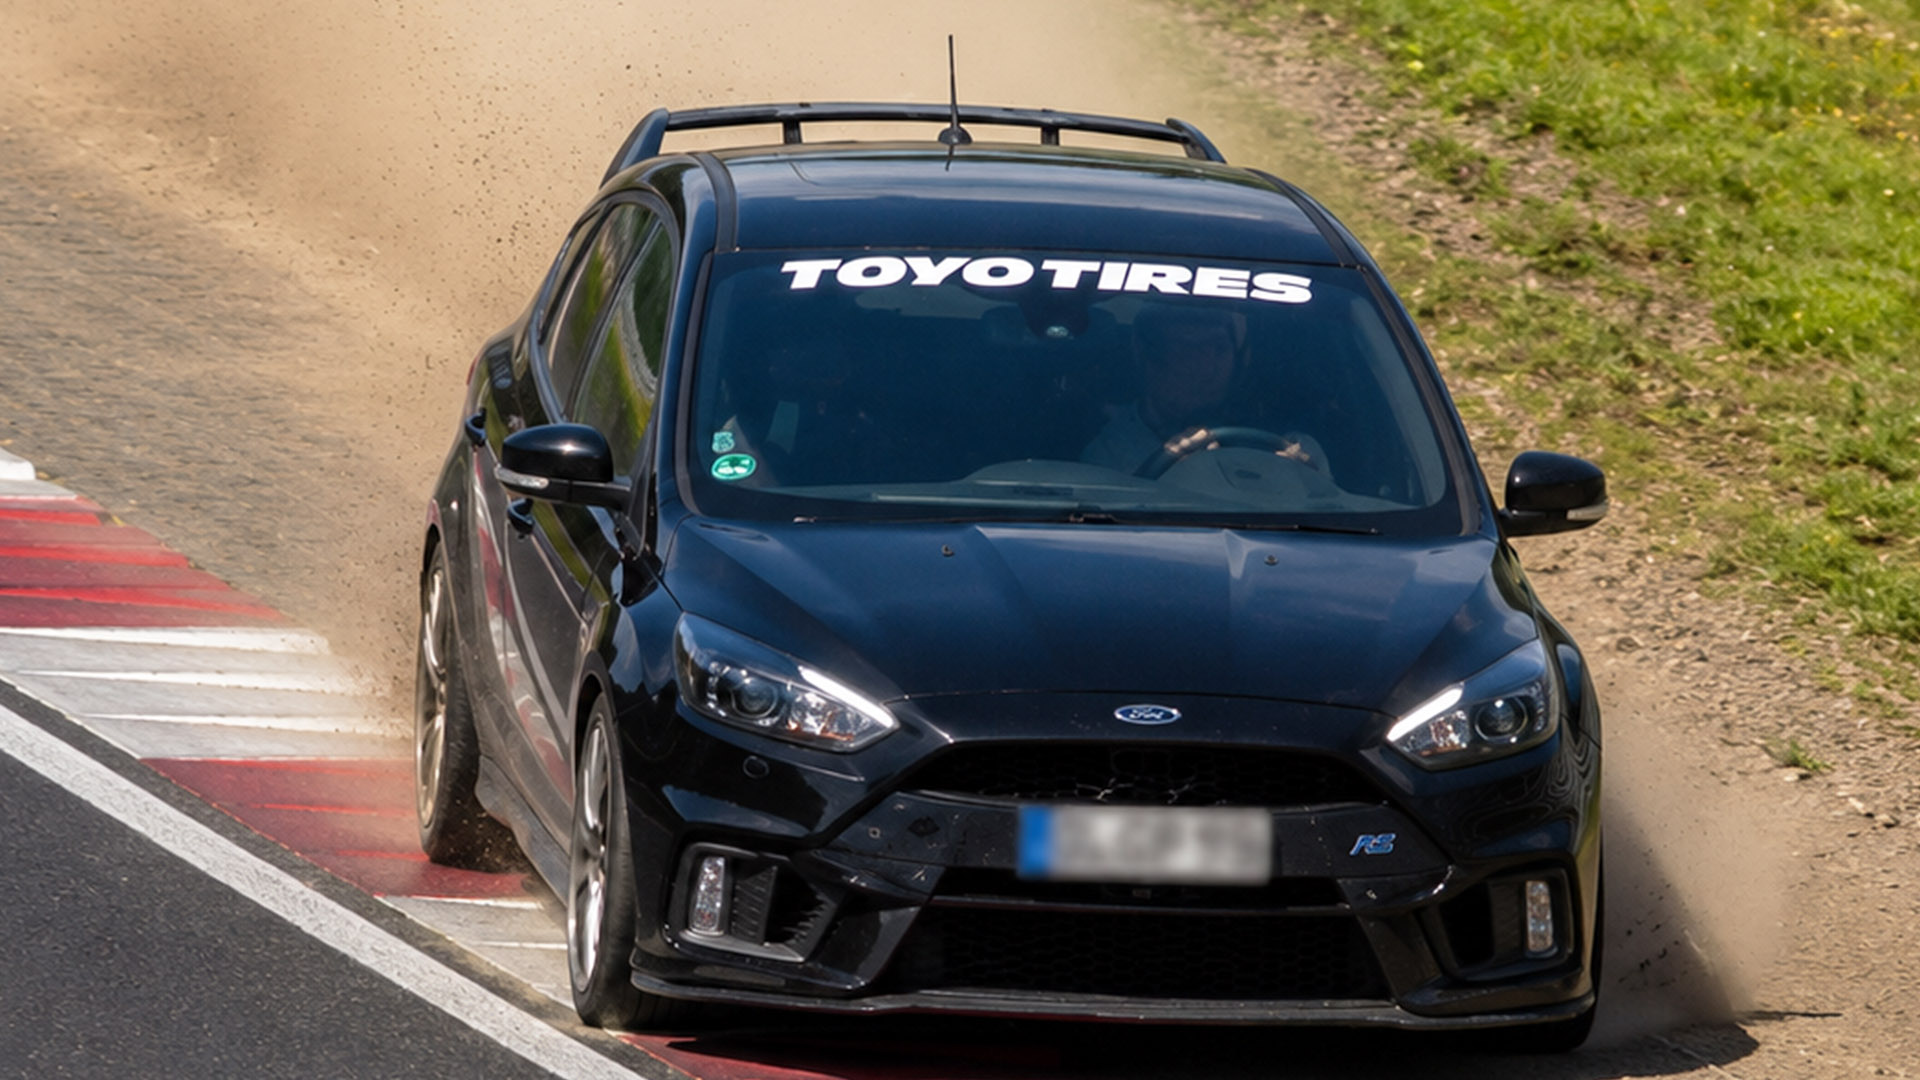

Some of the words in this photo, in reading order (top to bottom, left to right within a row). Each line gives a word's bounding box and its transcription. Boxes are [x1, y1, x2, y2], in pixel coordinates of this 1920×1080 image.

[781, 256, 1035, 290] TOYO
[1041, 259, 1313, 304] TIRES
[1349, 833, 1396, 856] RS
